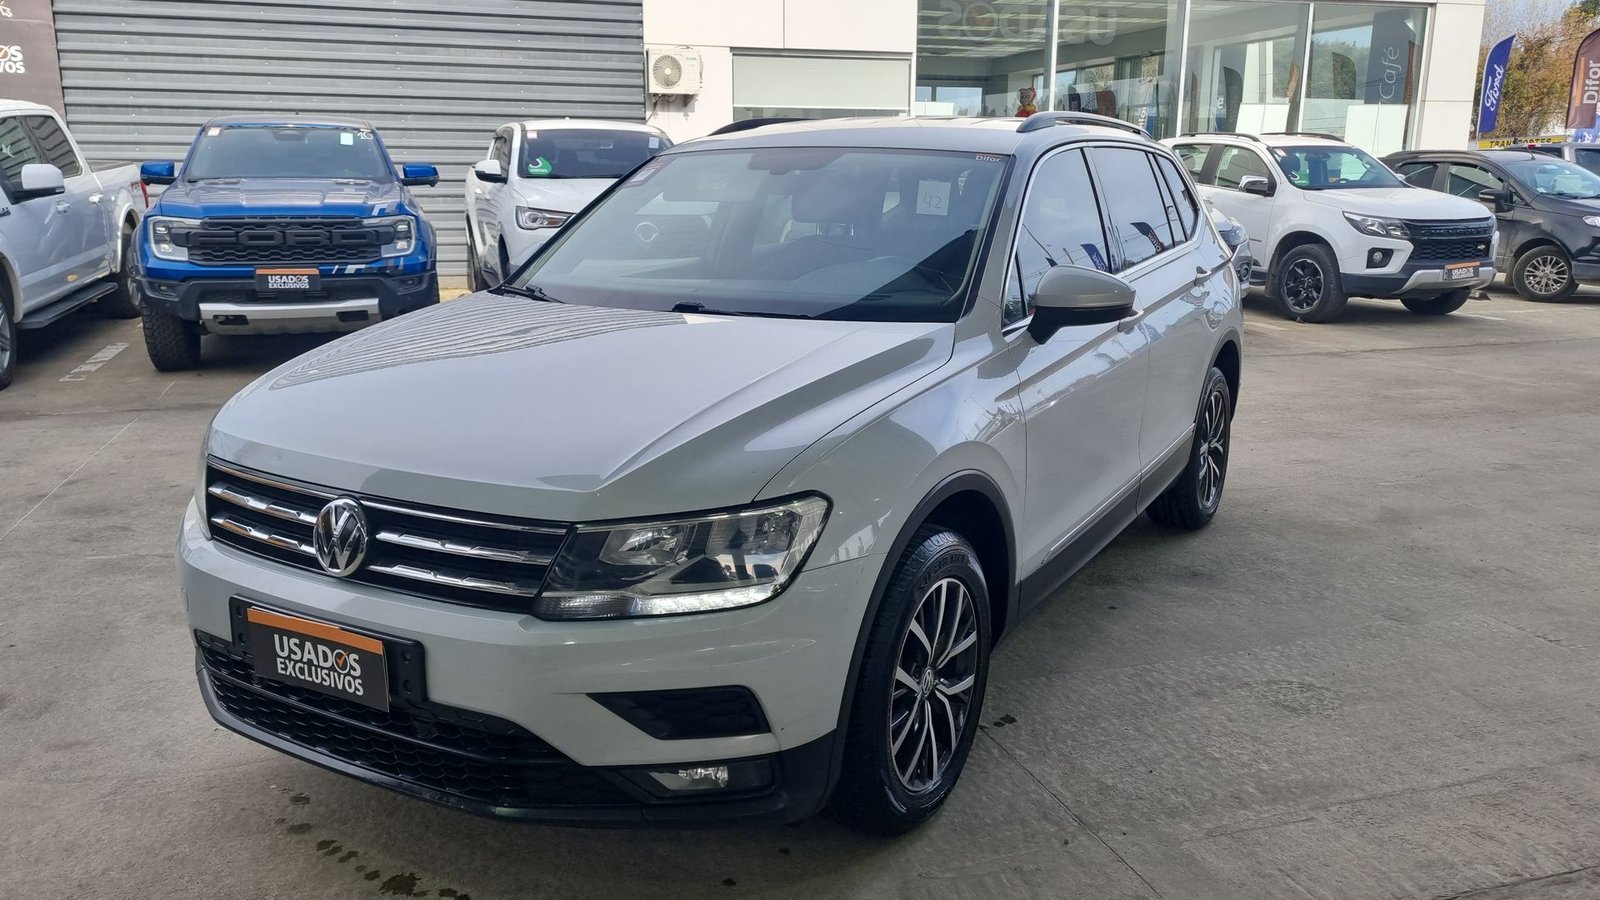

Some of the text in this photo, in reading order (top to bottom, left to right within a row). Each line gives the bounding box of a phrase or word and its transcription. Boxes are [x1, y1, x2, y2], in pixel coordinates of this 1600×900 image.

[1379, 46, 1402, 99] Café
[1484, 64, 1504, 112] Ford
[1583, 60, 1600, 104] Difor
[975, 154, 1001, 162] Difor
[922, 191, 942, 209] 42
[268, 275, 309, 283] USADOS
[273, 633, 362, 678] USADOS
[276, 657, 364, 697] EXCLUSIVOS
